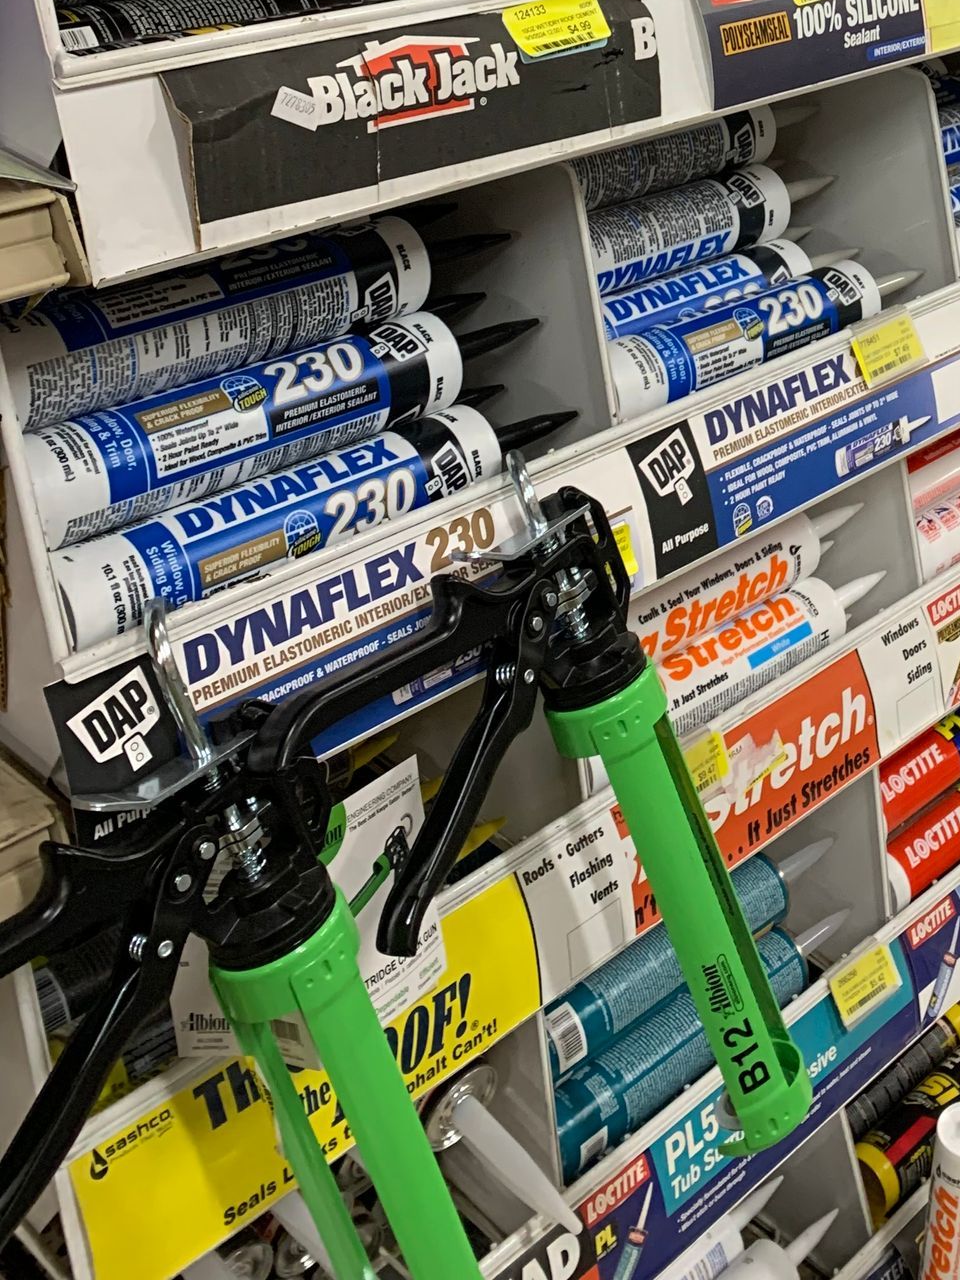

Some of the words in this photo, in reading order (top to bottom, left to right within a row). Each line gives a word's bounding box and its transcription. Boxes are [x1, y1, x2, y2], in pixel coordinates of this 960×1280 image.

[513, 4, 547, 20] 124133
[722, 15, 789, 53] POLYSEAMSEAL
[793, 0, 842, 39] 100%
[844, 25, 881, 49] Sealant
[307, 56, 429, 127] Black
[434, 40, 521, 98] Jack
[606, 257, 751, 321] DYNAFLEX
[758, 285, 824, 334] 230
[265, 343, 363, 406] 230
[705, 355, 851, 445] DYNAFLEX
[141, 405, 178, 422] SUPERIOR
[179, 393, 221, 411] FLEXIBILITY
[713, 438, 756, 461] PREMIUM
[757, 407, 809, 440] ELASTOMERIC
[173, 438, 401, 539] DYNAFLEX
[662, 537, 679, 555] All
[680, 521, 710, 550] Purpose
[182, 543, 426, 684] DYNAFLEX
[425, 509, 497, 573] 230
[638, 606, 659, 626] Caulk
[668, 593, 684, 609] Seal
[684, 585, 701, 600] Your
[700, 565, 734, 591] Windows,
[735, 555, 755, 572] Doors
[762, 541, 783, 560] Siding
[662, 554, 788, 647] Stretch
[881, 617, 919, 646] Windows
[902, 638, 927, 661] Doors
[192, 663, 262, 706] PREMIUM
[262, 615, 353, 672] ELASTOMERIC
[347, 792, 386, 824] ENGINEERING
[386, 774, 413, 796] COMPANY
[522, 859, 555, 886] Roofs
[566, 826, 604, 858] Gutters
[569, 853, 613, 889] Flashing
[590, 880, 619, 906] Vents
[722, 1016, 771, 1095] B12
[223, 1177, 278, 1228] Seals
[587, 1160, 647, 1224] LOCTITE
[595, 1230, 618, 1256] PL
